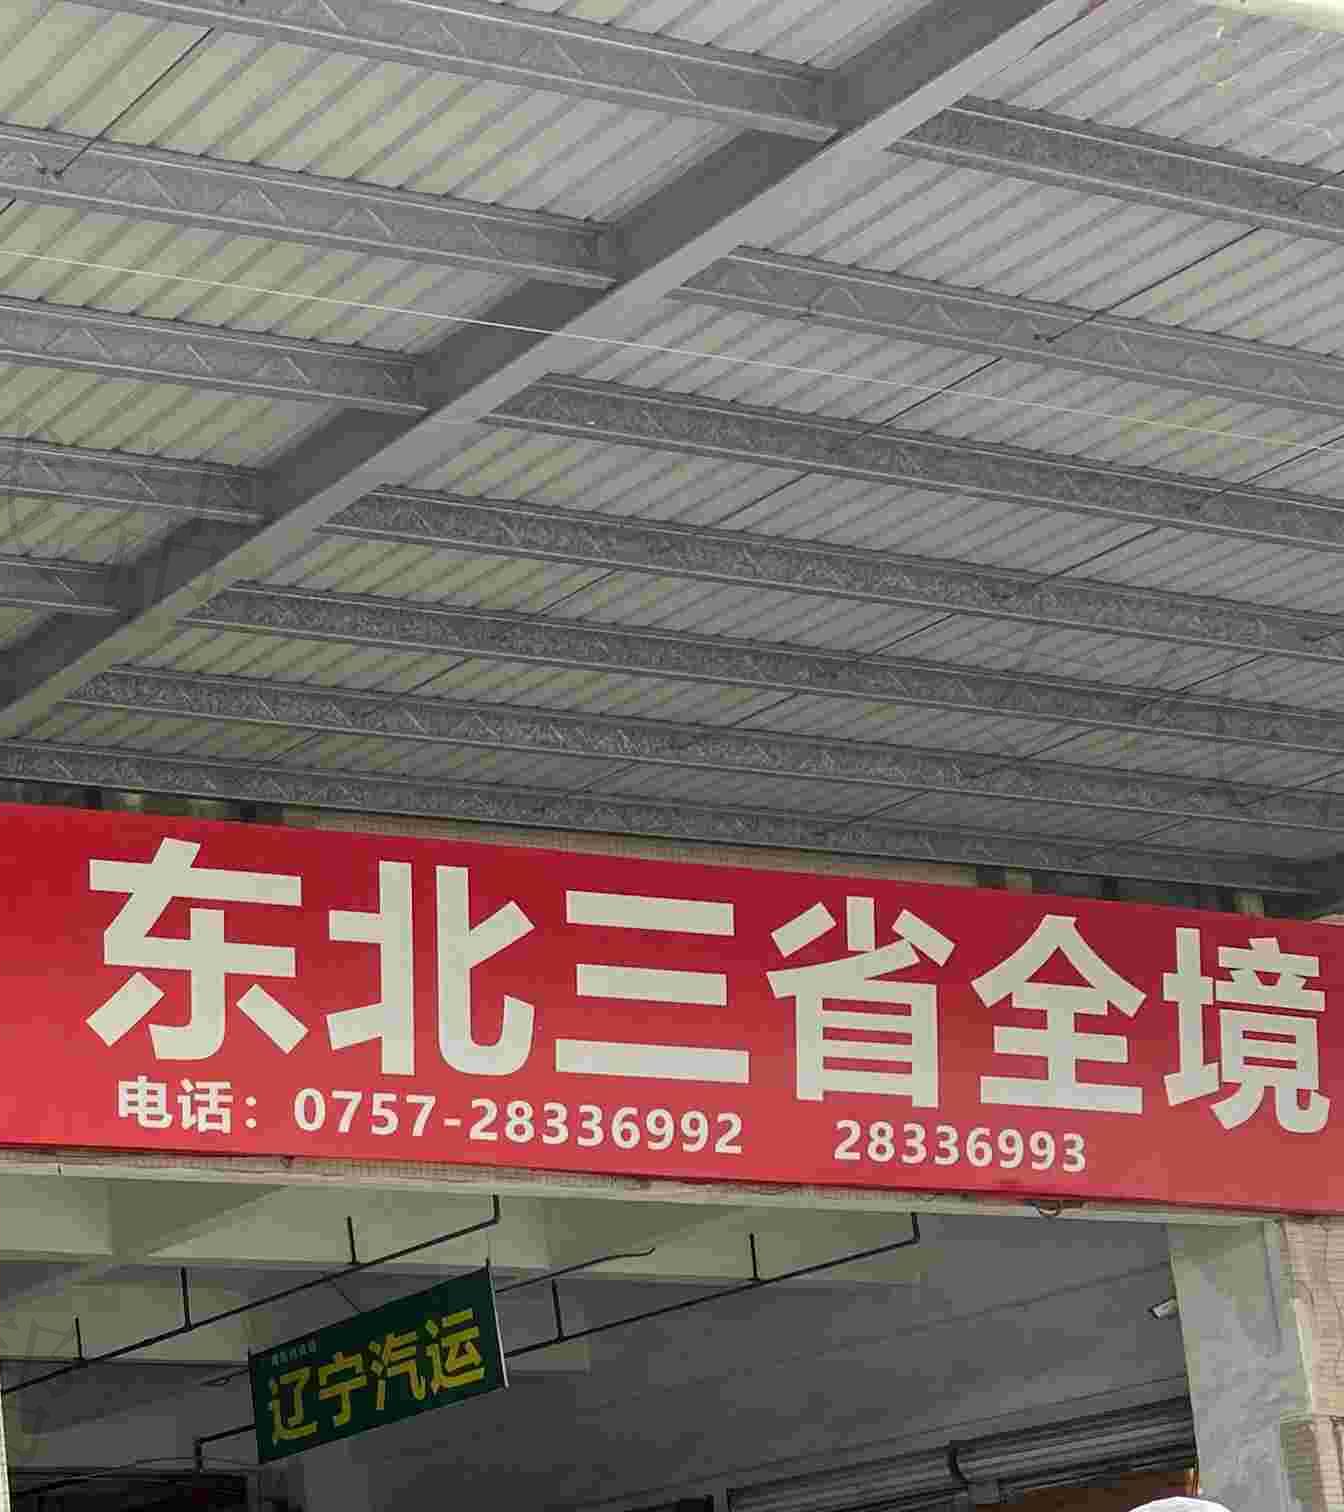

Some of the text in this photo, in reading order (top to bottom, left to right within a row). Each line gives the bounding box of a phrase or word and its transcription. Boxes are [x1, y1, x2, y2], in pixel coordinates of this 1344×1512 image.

[85, 837, 1331, 1134] 东北三省全境
[833, 1119, 1089, 1174] 28336993
[269, 1308, 486, 1446] 辽宁汽运
